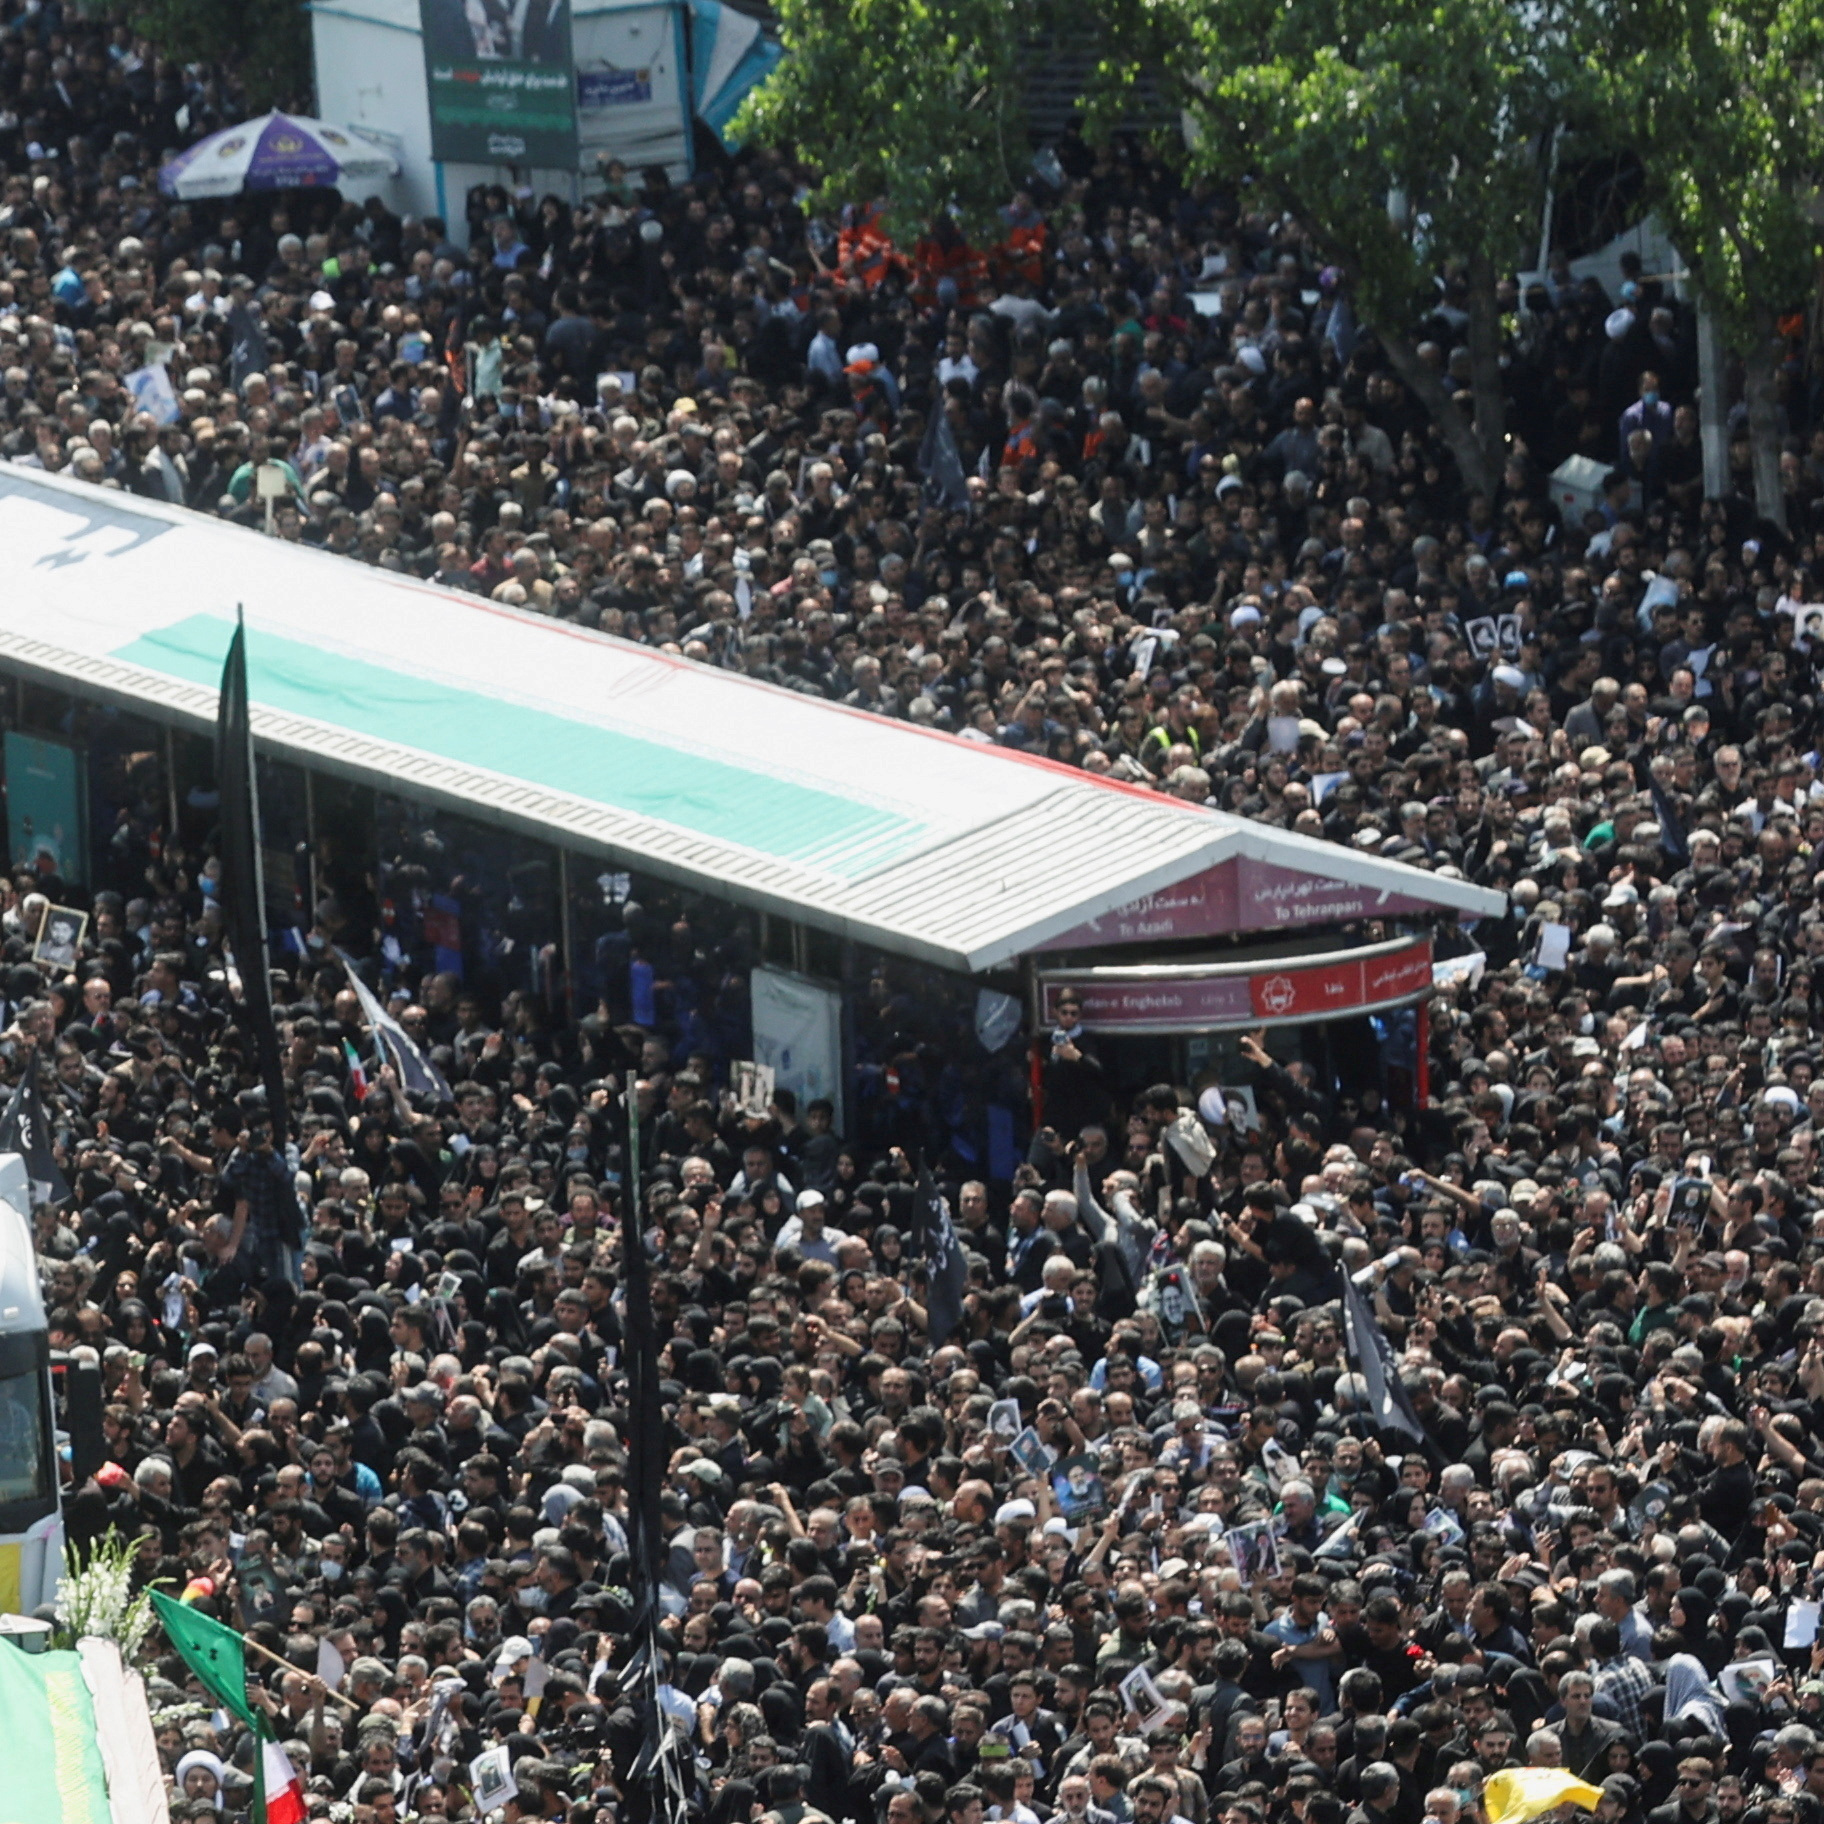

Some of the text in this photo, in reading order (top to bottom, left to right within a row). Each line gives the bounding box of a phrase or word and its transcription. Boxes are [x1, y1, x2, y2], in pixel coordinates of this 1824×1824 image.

[1274, 899, 1364, 921] To Tehranpars
[1122, 994, 1184, 1011] Enghelab
